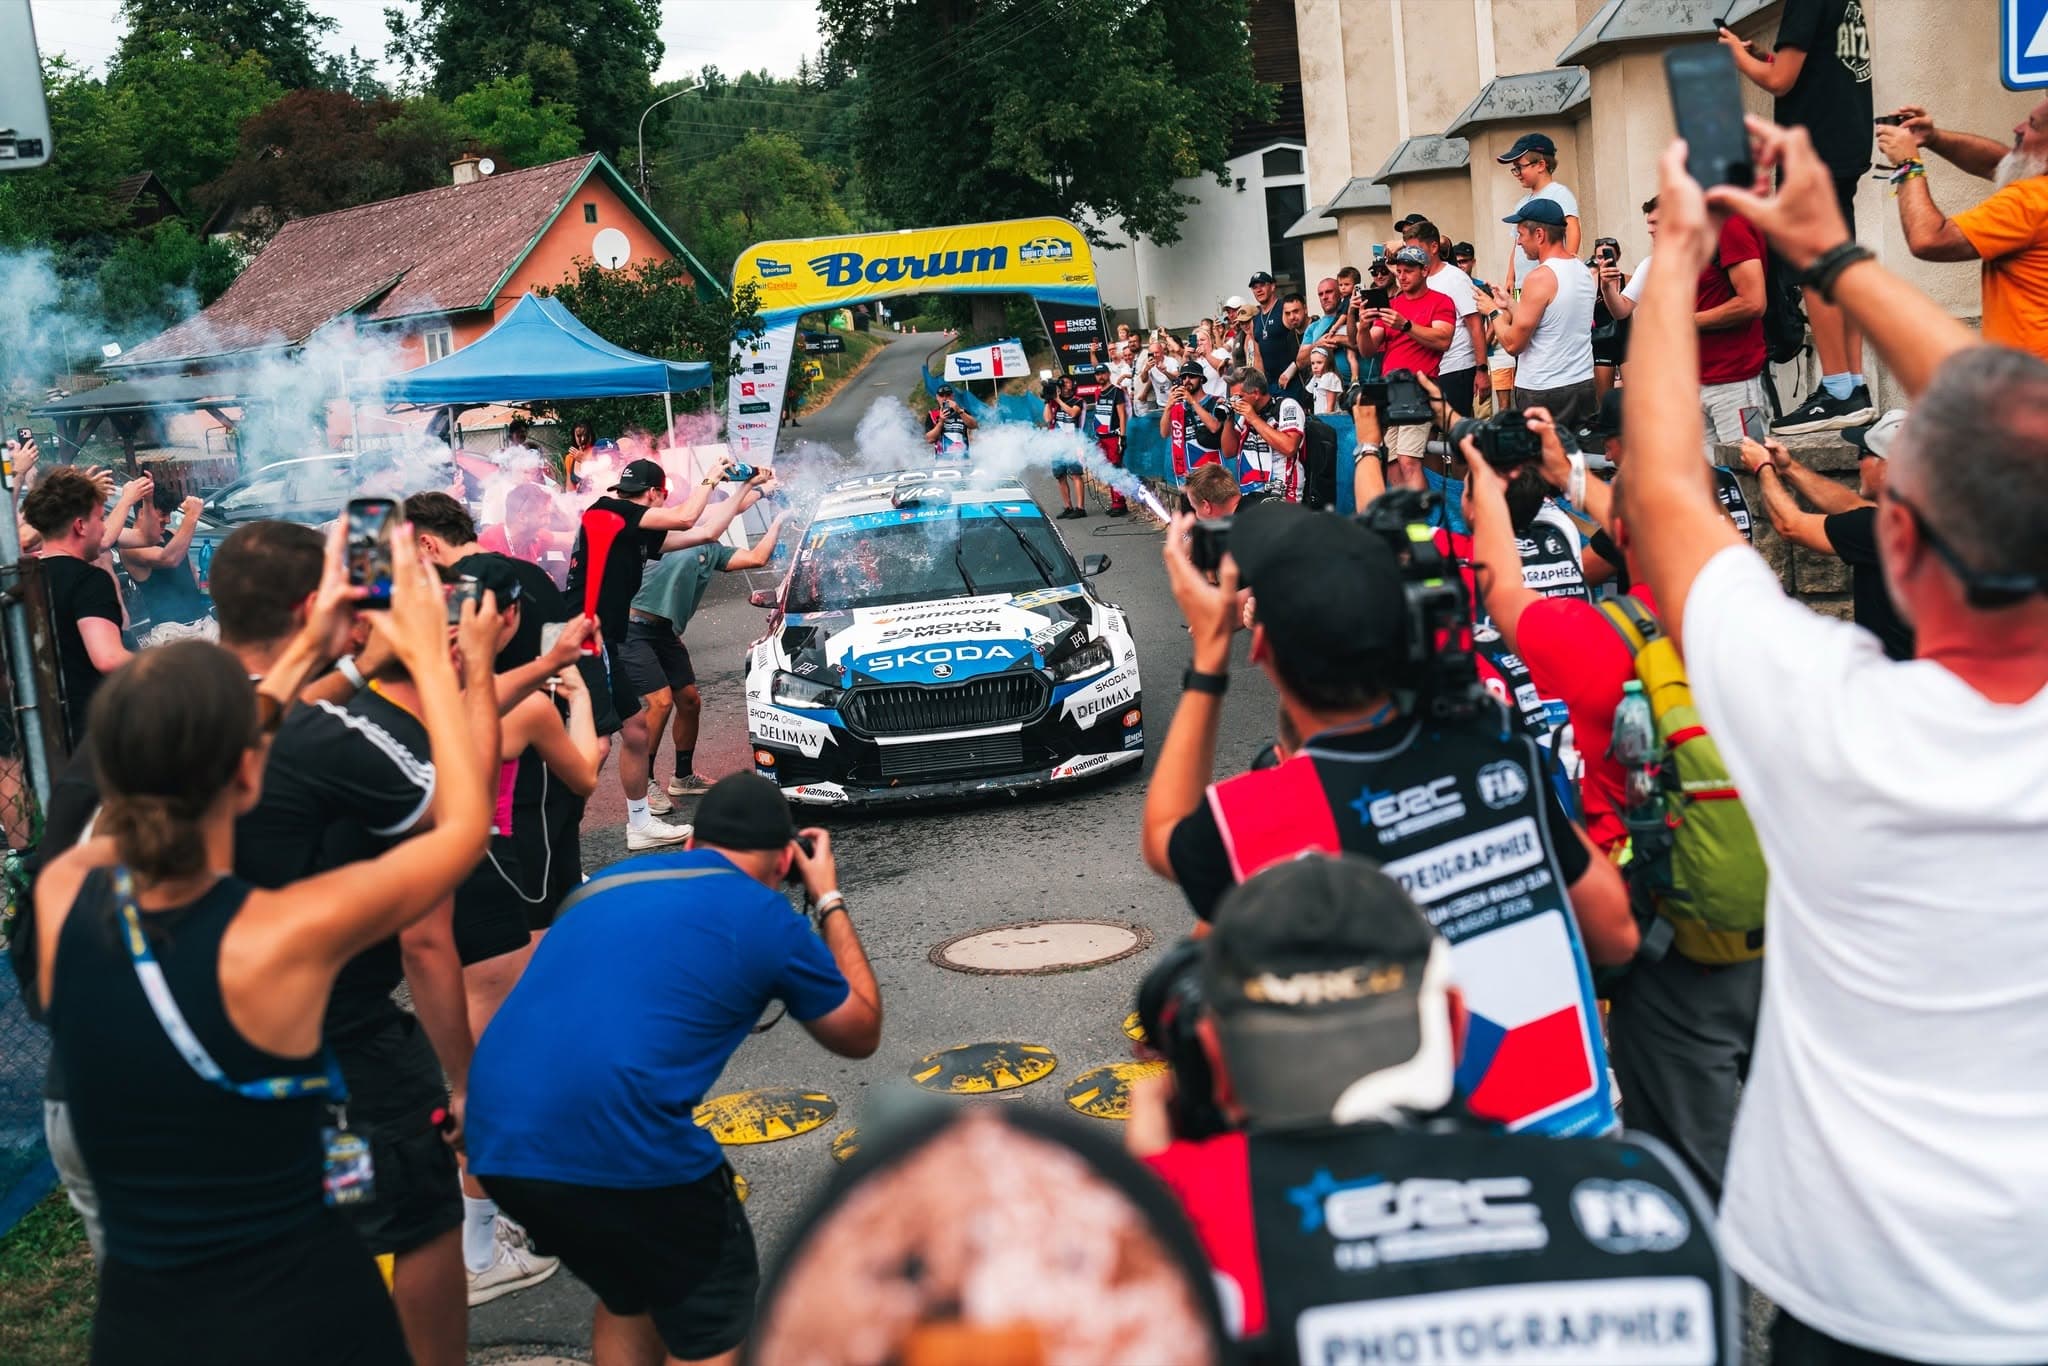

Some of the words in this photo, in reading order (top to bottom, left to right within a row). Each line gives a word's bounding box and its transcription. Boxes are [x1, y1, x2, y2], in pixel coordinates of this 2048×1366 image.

[808, 246, 1007, 287] Barum
[1066, 317, 1097, 328] ENEOS
[1523, 566, 1579, 582] GRAPHER
[913, 626, 1001, 639] MOTOR
[1076, 686, 1132, 720] DELIMAX
[759, 723, 818, 748] DELIMAX
[1478, 766, 1526, 804] FIA
[1398, 831, 1535, 893] DEOGRAPHER
[1575, 1187, 1686, 1240] FIA
[1323, 1308, 1691, 1366] PHOTOGRAPHER
